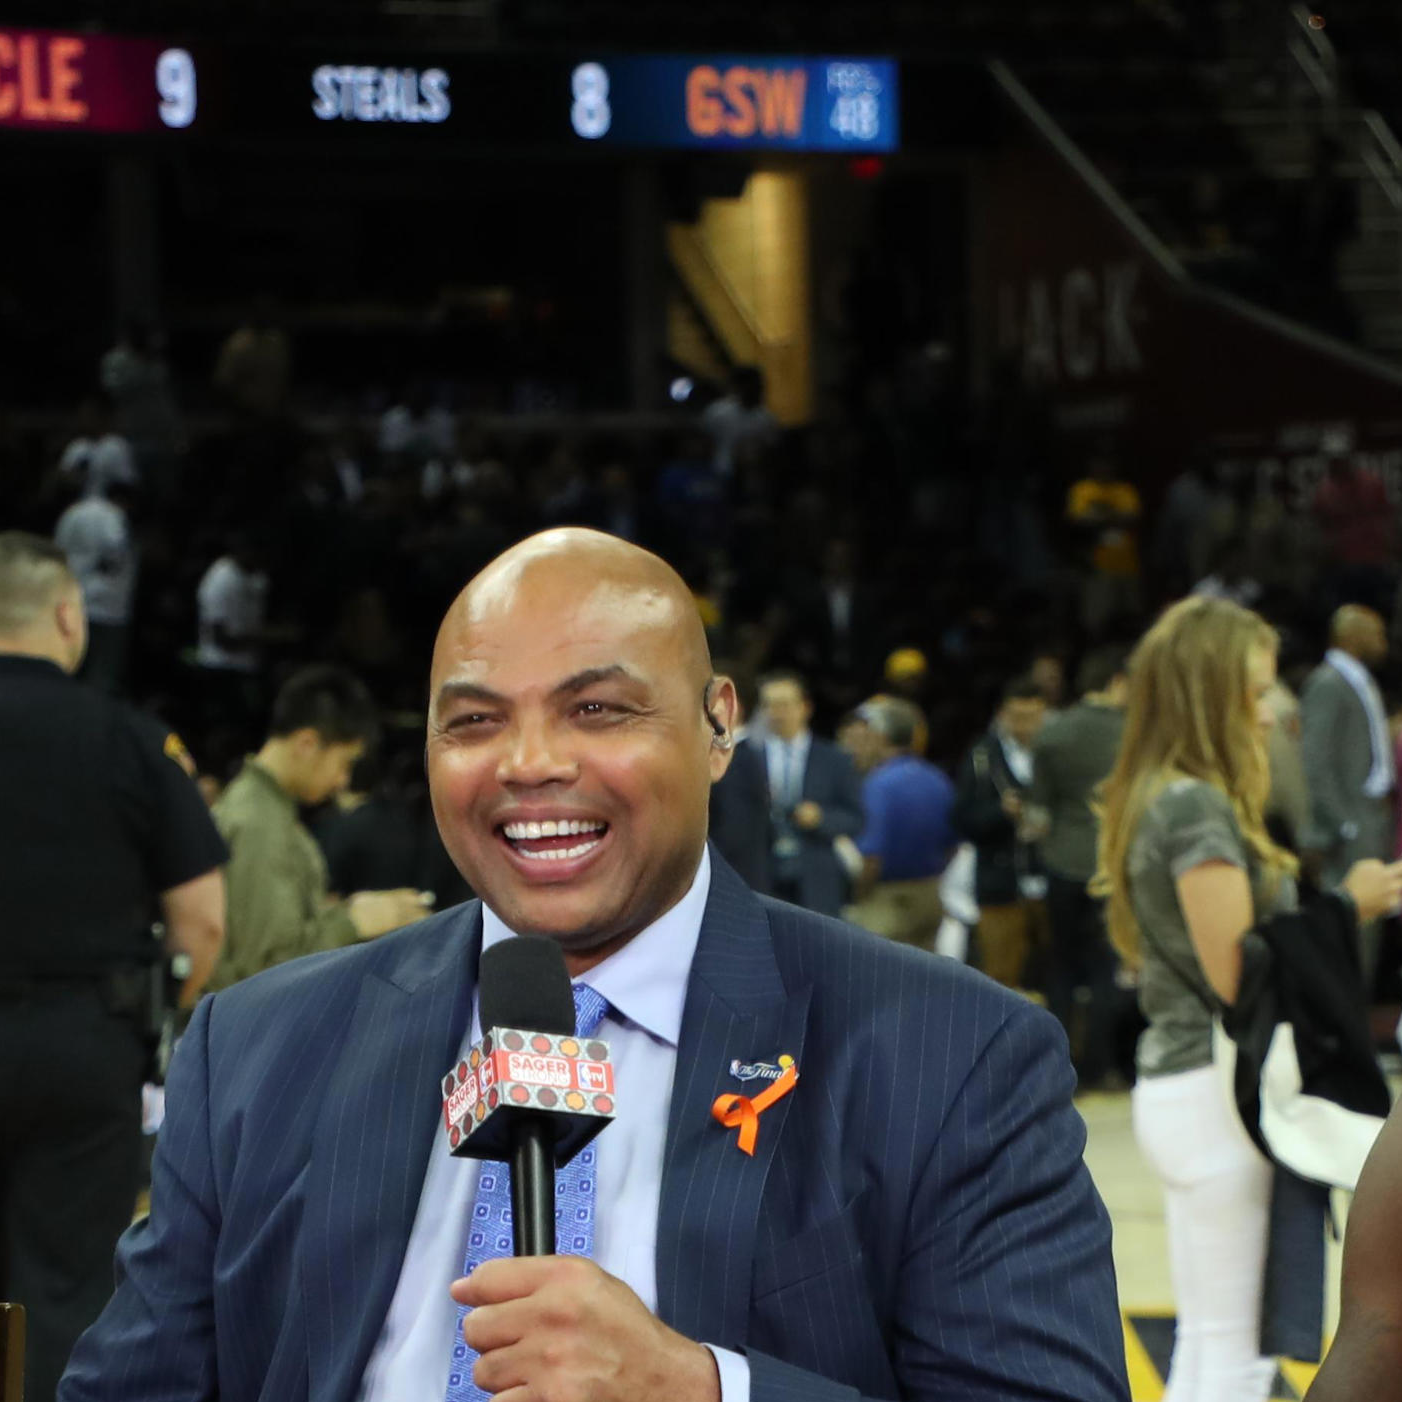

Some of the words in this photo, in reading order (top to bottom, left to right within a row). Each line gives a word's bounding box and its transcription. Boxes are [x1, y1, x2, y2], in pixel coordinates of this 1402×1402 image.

[156, 48, 197, 128] 9
[312, 64, 450, 123] STEALS
[571, 62, 611, 139] 8
[685, 64, 807, 138] GSW
[511, 1055, 567, 1073] SAGER
